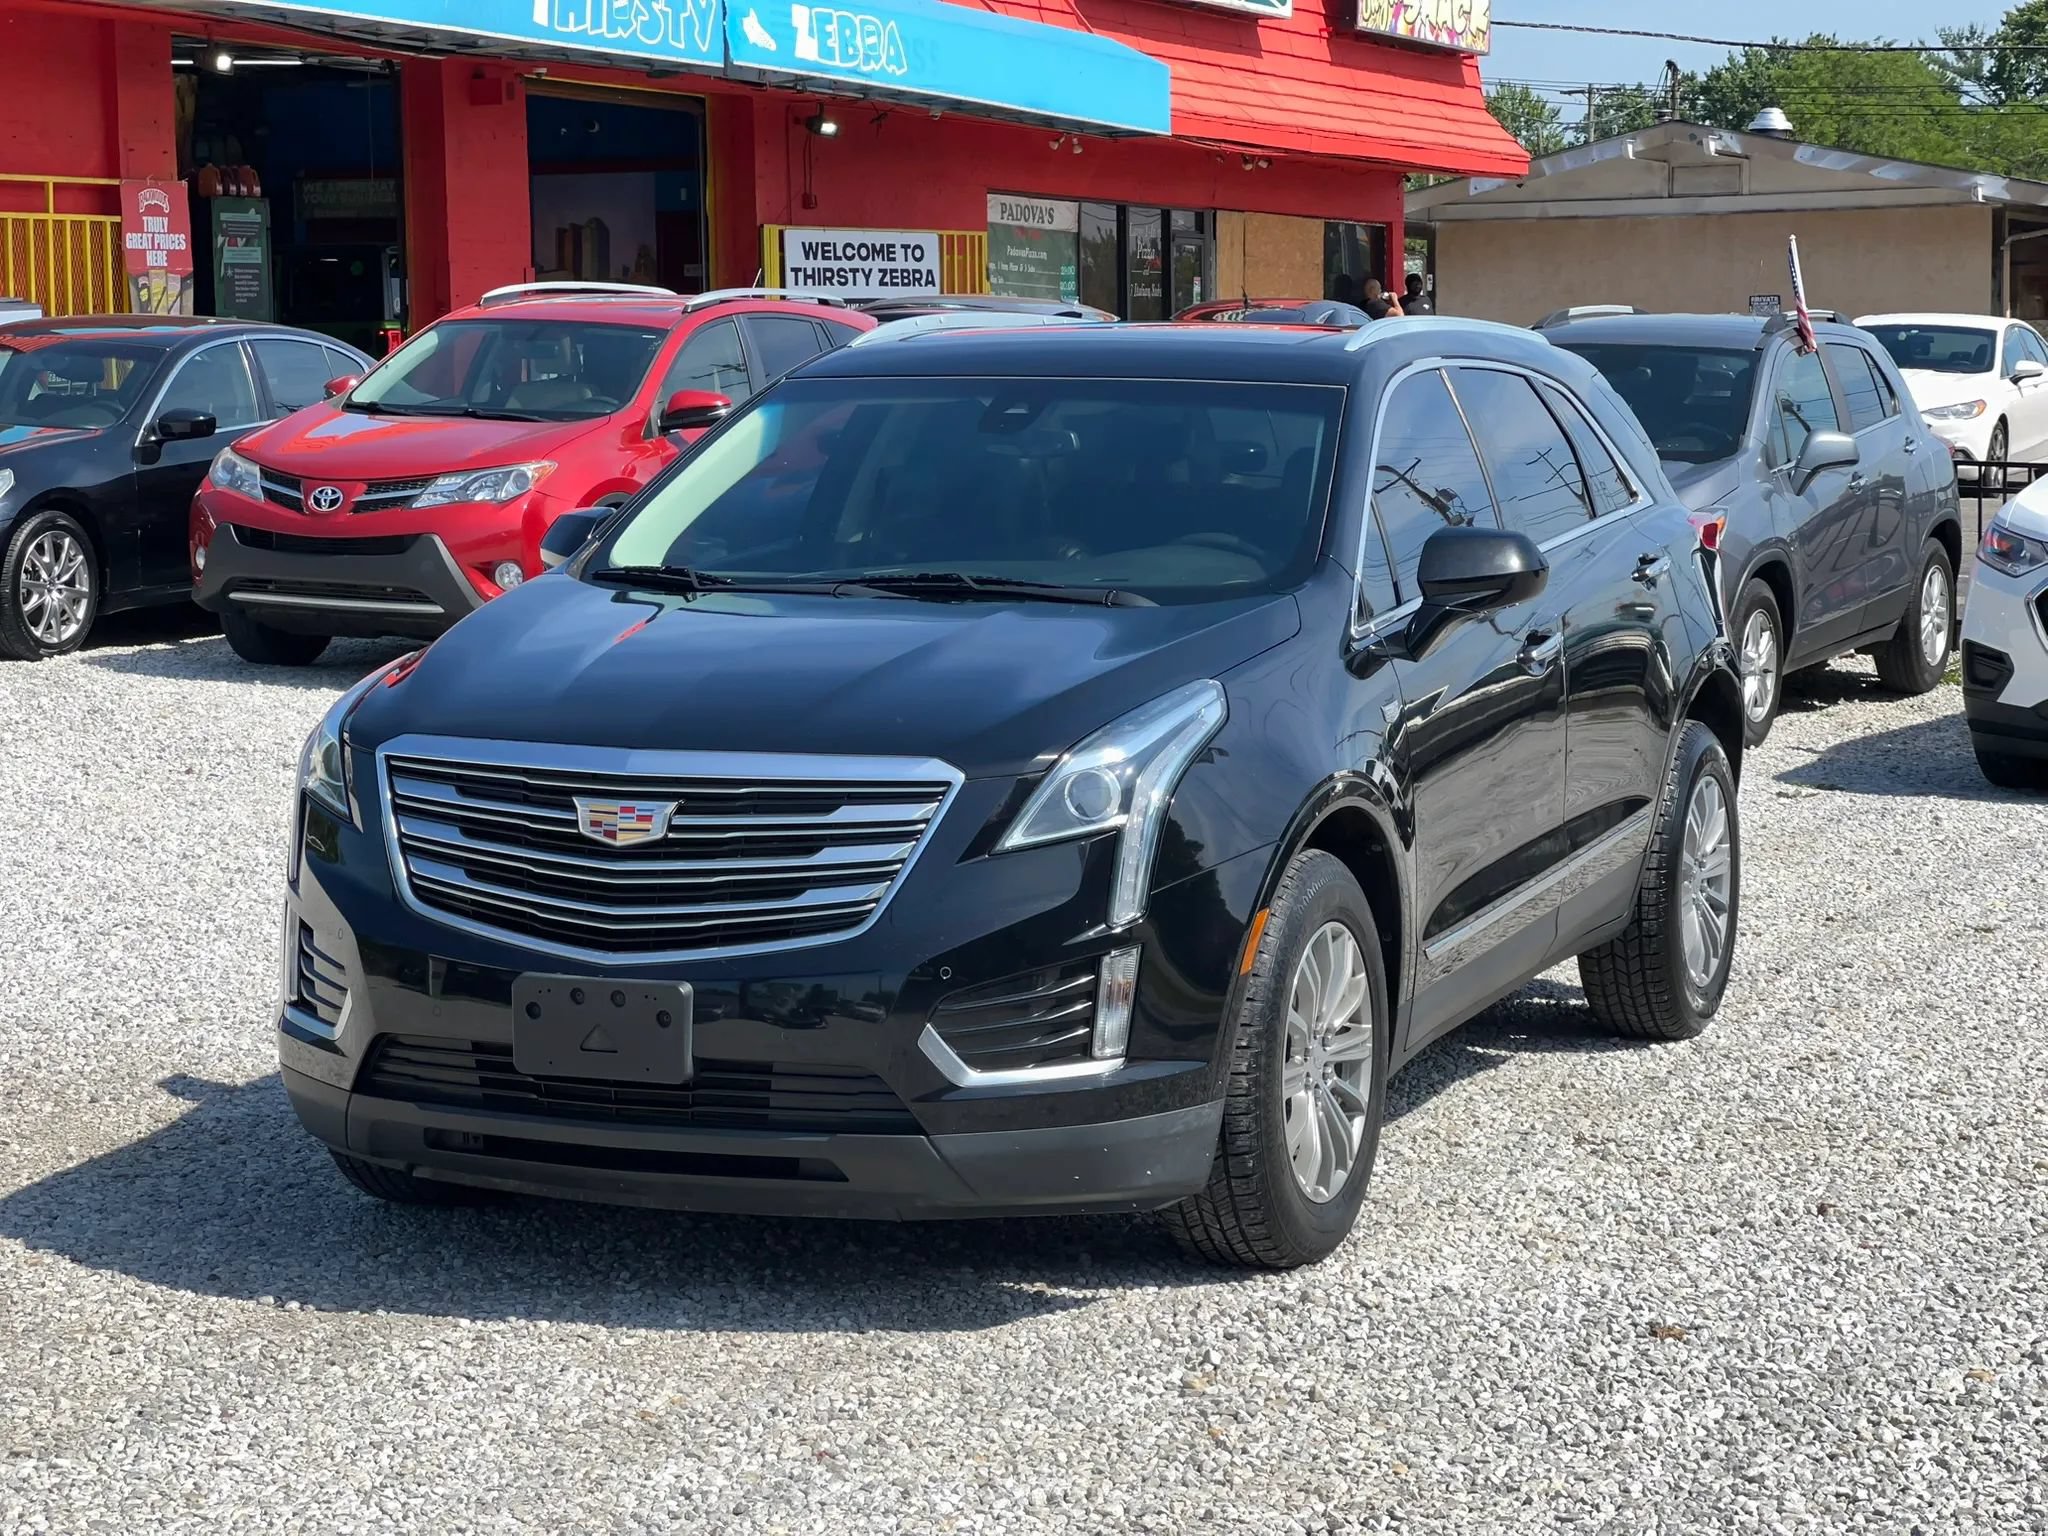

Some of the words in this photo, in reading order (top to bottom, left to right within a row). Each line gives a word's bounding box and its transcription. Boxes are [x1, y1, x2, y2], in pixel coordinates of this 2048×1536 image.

[792, 3, 908, 76] ZEBRA
[1000, 202, 1055, 224] PADOVA'S
[142, 216, 168, 233] TRULY
[126, 233, 153, 249] GREAT
[154, 234, 186, 250] PRICES
[146, 250, 168, 266] HERE
[801, 241, 896, 262] WELCOME
[901, 243, 925, 263] TO
[790, 267, 873, 287] THIRSTY
[878, 268, 936, 287] ZEBRA
